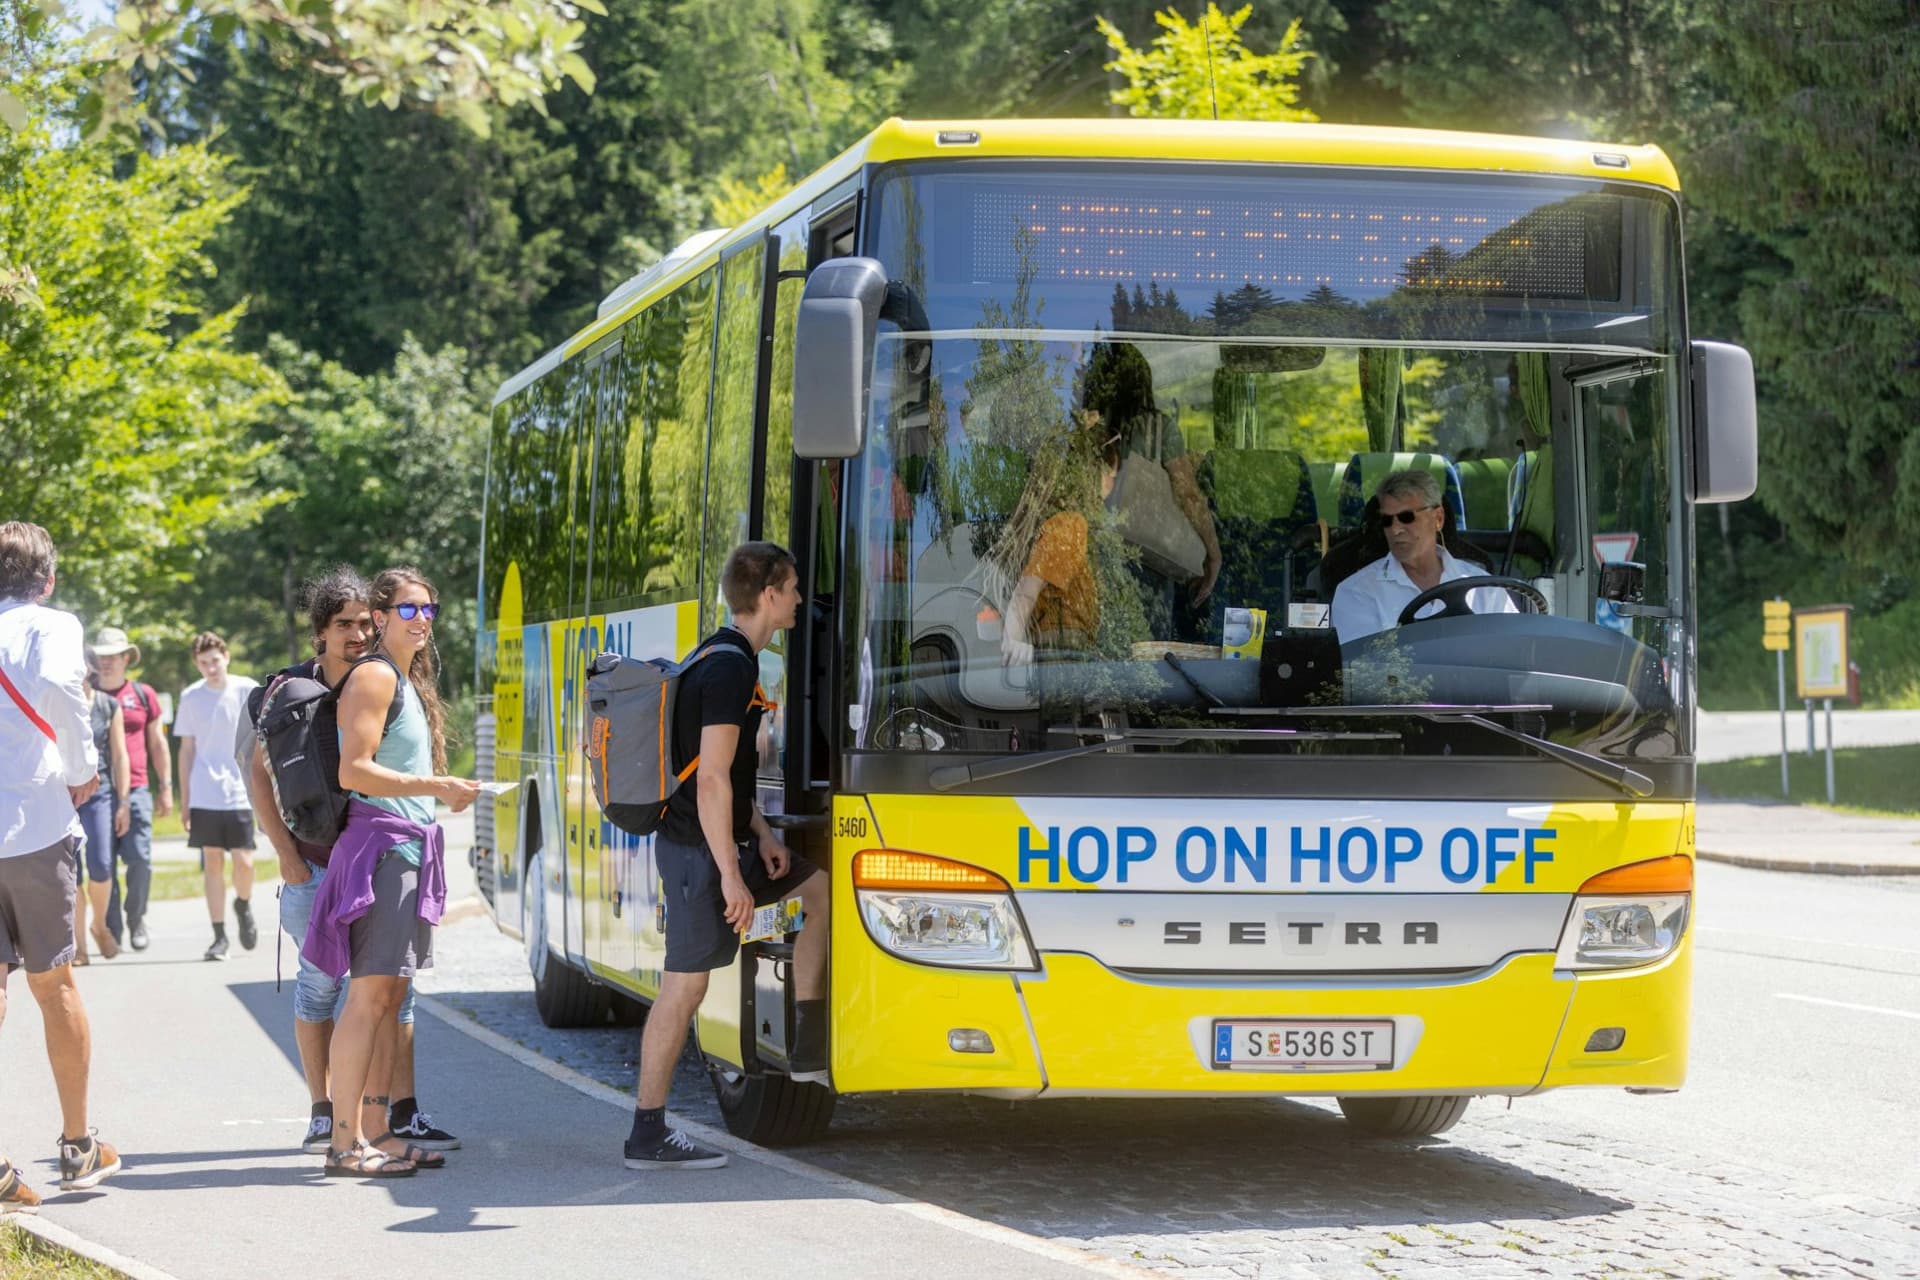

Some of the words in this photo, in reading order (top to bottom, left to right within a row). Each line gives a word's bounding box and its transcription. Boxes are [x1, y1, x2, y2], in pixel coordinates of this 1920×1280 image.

[839, 816, 867, 838] 5460
[1018, 826, 1157, 883] HOP
[1175, 826, 1267, 883] ON
[1290, 826, 1423, 884] HOP
[1440, 827, 1557, 884] OFF
[1164, 922, 1438, 944] SETRA
[1220, 1047, 1227, 1056] A
[1248, 1031, 1262, 1056] S
[1285, 1031, 1334, 1057] 536
[1343, 1031, 1374, 1057] ST
